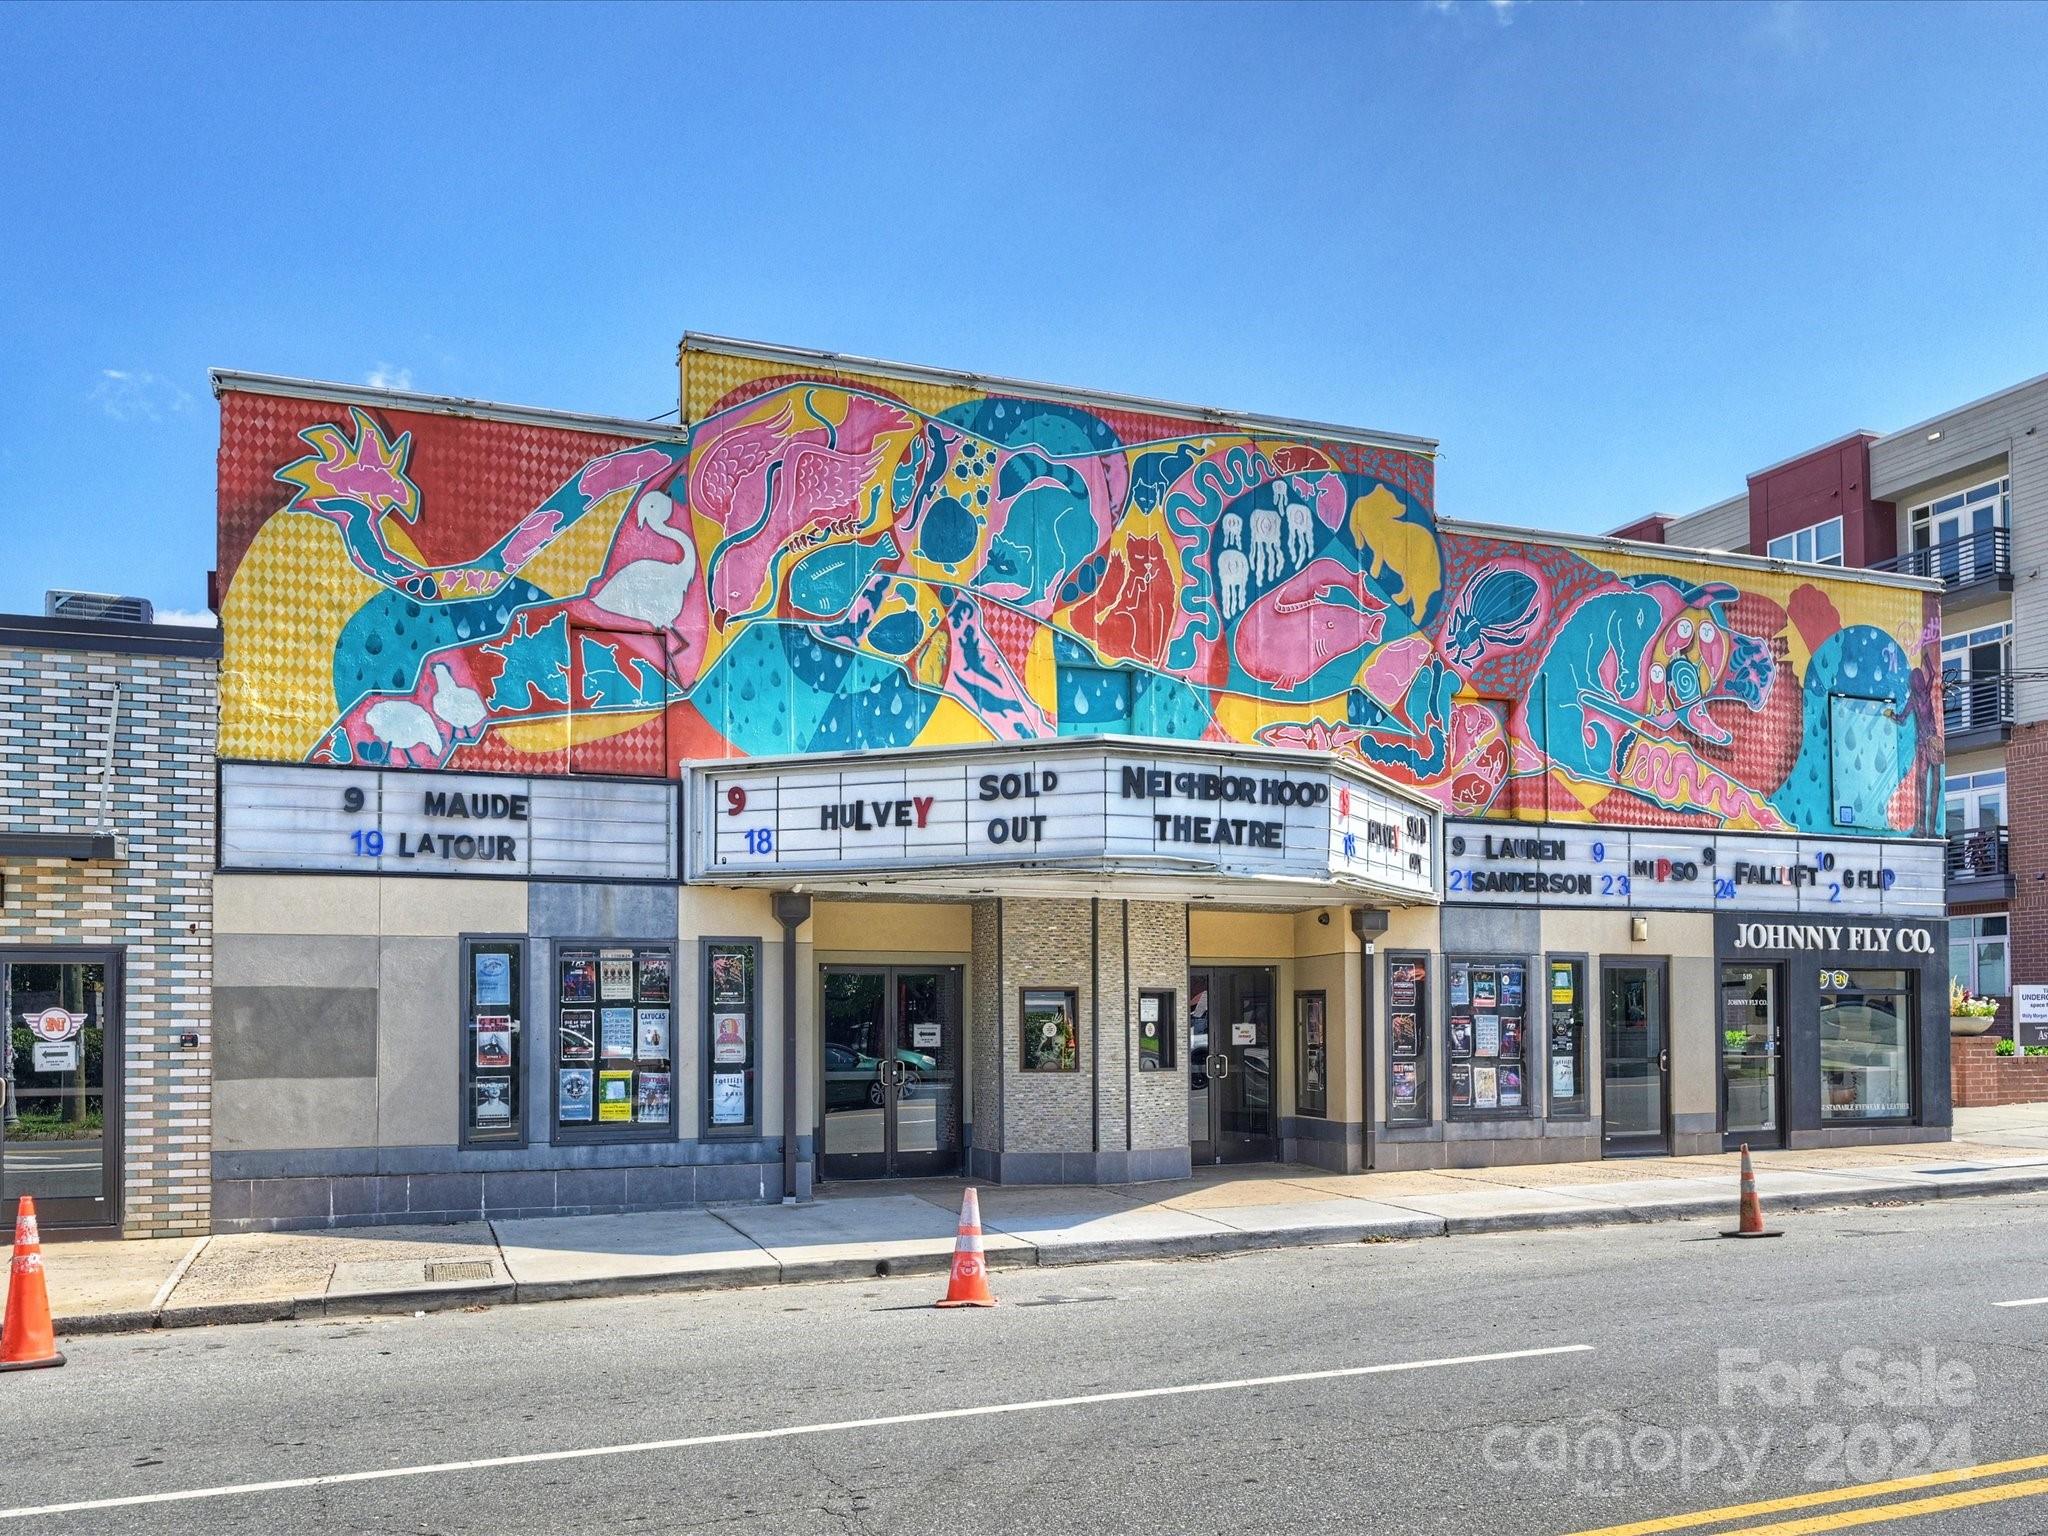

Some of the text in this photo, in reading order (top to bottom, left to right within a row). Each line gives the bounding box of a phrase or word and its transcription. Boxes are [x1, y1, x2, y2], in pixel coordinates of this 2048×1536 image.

[979, 770, 1058, 801] SOLD
[1122, 765, 1329, 808] NEIGHBORHOOD
[343, 786, 528, 821] 9 MAUDE
[727, 786, 746, 816] 9
[820, 796, 934, 831] HULVEY
[744, 828, 773, 855] 18
[987, 816, 1047, 844] OUT
[1153, 815, 1283, 849] THEATRE
[350, 829, 516, 861] 19 LATOUR
[1452, 835, 1566, 860] 9 LAUREN
[1593, 842, 1605, 863] 9
[1703, 846, 1716, 867] 9
[1634, 858, 1698, 882] MIPSO
[1815, 851, 1835, 872] 10
[1450, 869, 1592, 895] 21 SANDERSON
[1602, 875, 1630, 896] 23
[1714, 879, 1737, 899] 24
[1858, 868, 1896, 891] FLIP
[1829, 883, 1842, 903] 2
[1734, 923, 1935, 954] JOHNNY FLY CO.
